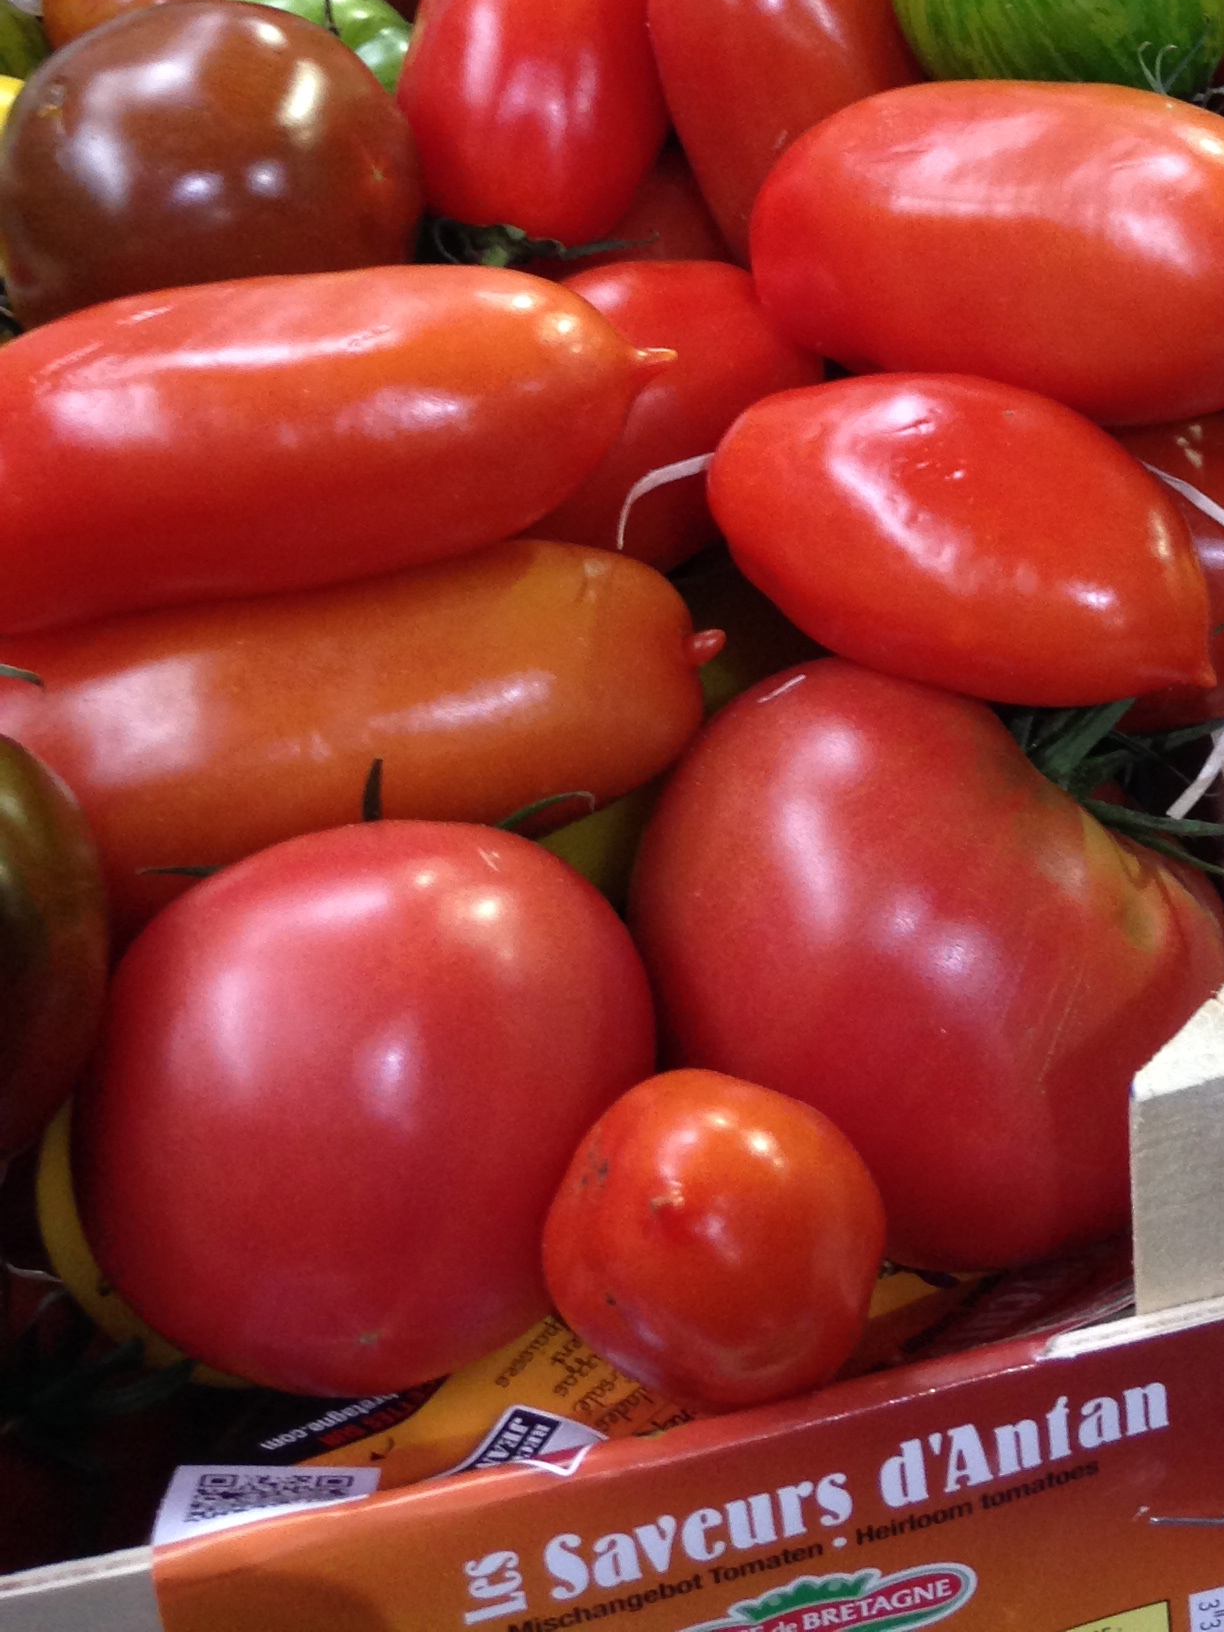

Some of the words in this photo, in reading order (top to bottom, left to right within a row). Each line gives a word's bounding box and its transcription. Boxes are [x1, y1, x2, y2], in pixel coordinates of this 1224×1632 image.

[507, 1573, 704, 1632] Mischangebot
[711, 1541, 824, 1585] Tomaten
[855, 1499, 974, 1546] Heirloom
[981, 1459, 1100, 1511] tomatoes
[544, 1472, 853, 1601] Saveurs
[880, 1381, 1169, 1508] d'Antan
[802, 1577, 953, 1631] BRETAGNE
